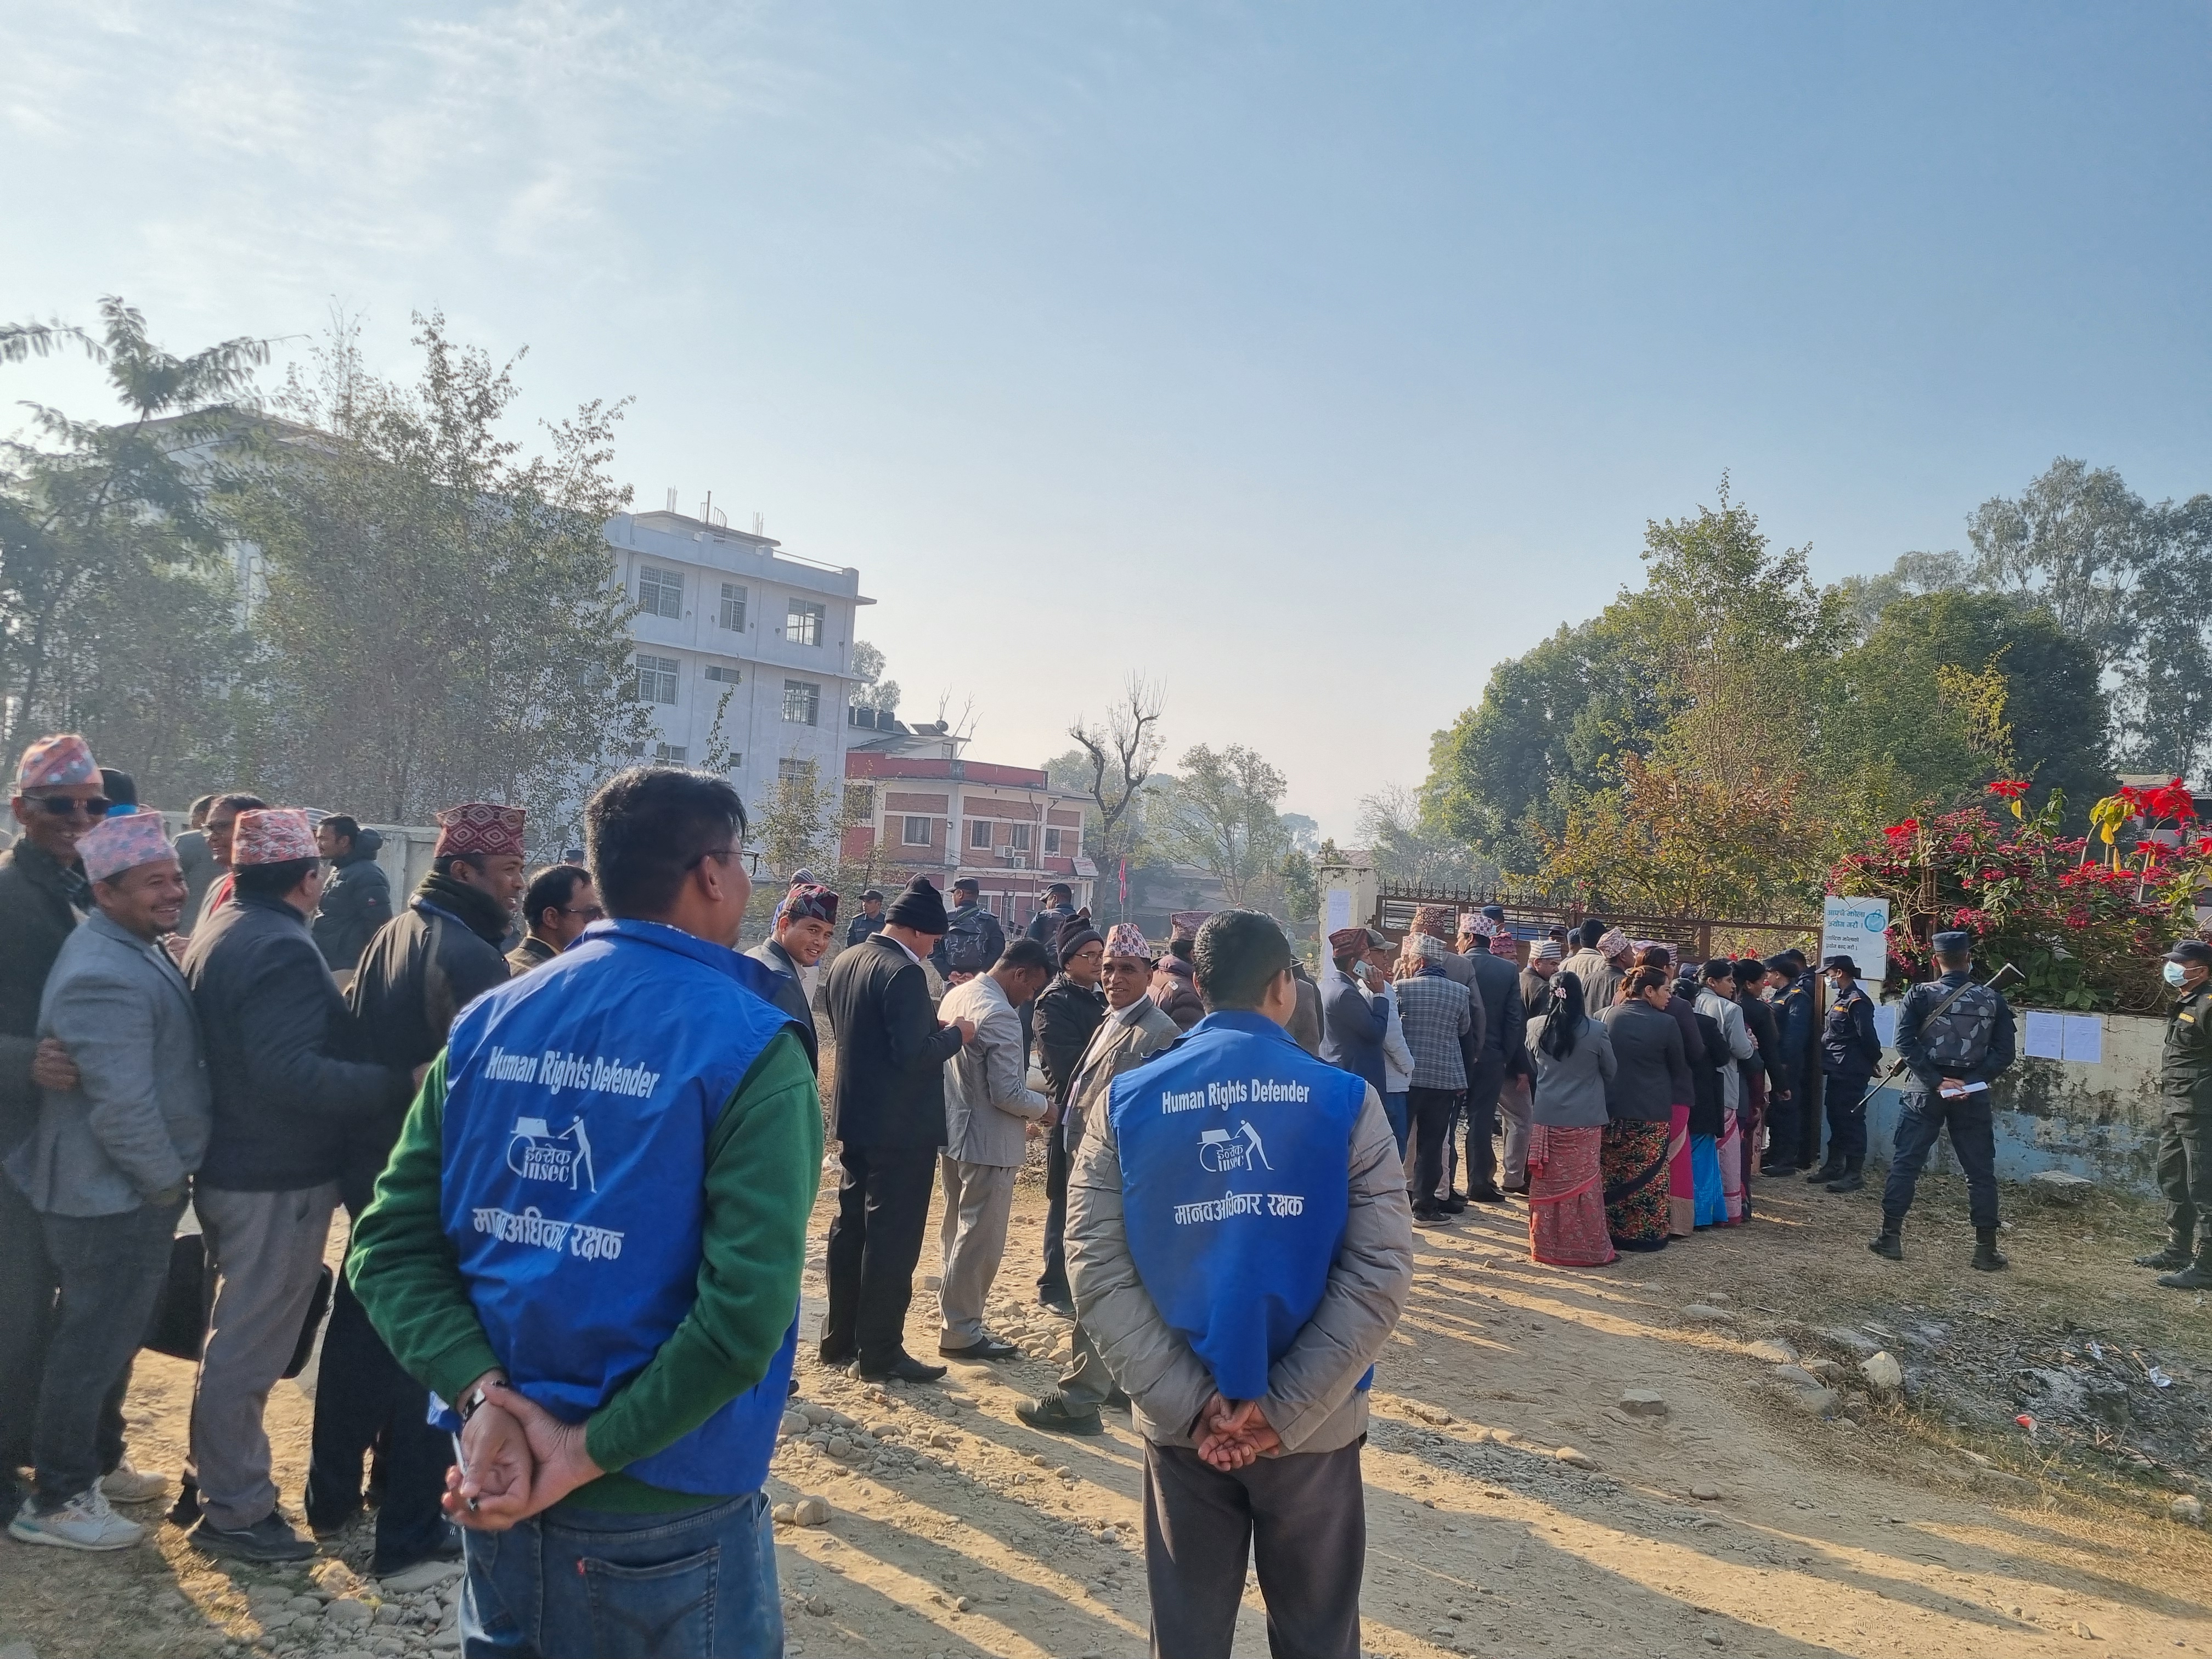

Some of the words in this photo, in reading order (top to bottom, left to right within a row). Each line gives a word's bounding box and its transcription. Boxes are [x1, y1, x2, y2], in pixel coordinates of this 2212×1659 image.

[485, 1046, 538, 1084] Human
[538, 1050, 591, 1095] Rights
[591, 1057, 660, 1098] Defender
[1163, 1091, 1205, 1114] Human
[1209, 1079, 1248, 1111] Rights
[1251, 1079, 1310, 1103] Defender
[1267, 1193, 1305, 1218] रक्षक
[571, 1223, 624, 1262] रक्षक
